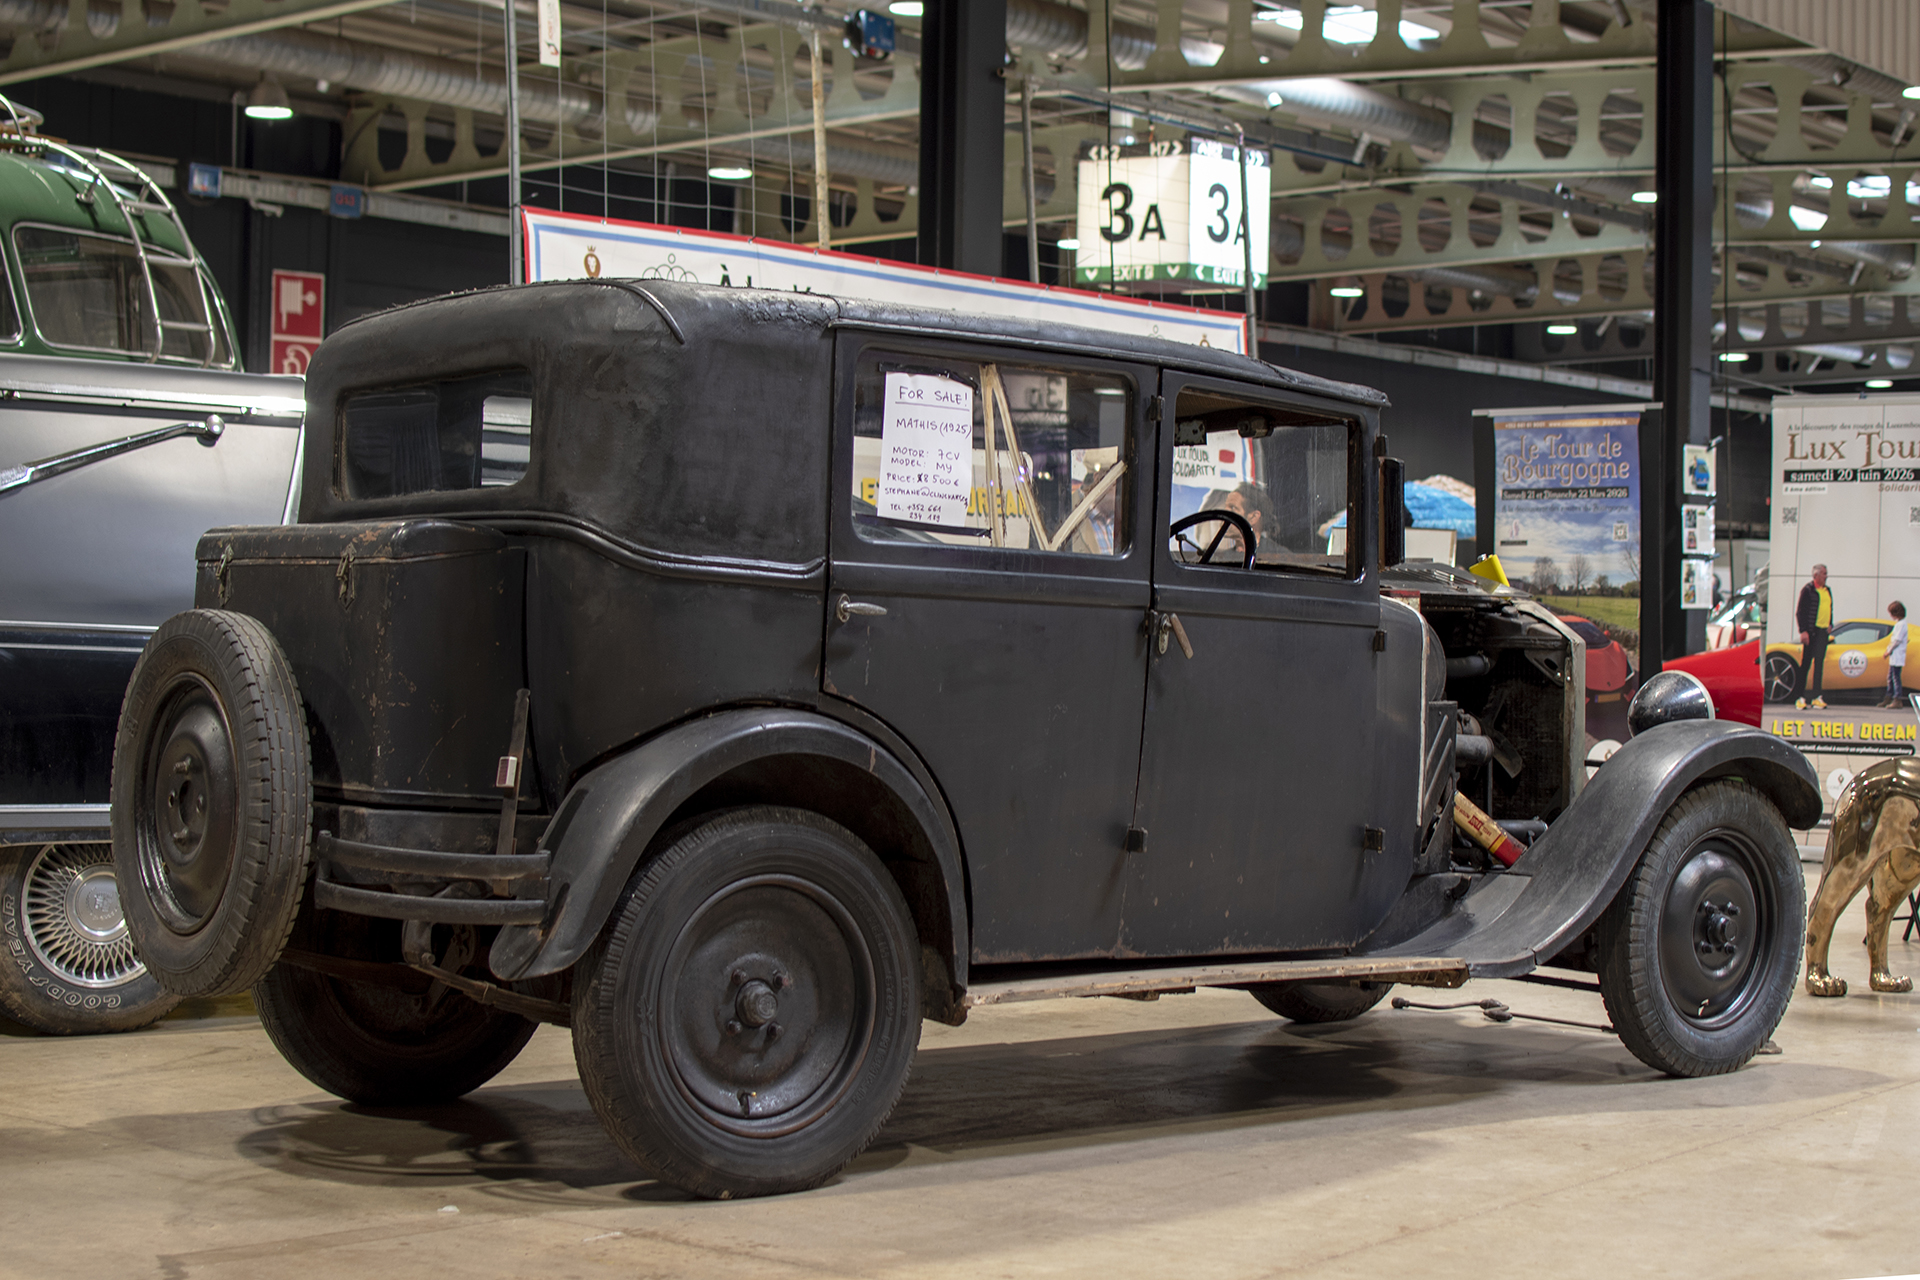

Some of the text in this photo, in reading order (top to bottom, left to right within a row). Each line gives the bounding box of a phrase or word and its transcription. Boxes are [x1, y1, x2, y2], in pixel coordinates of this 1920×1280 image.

[1100, 182, 1166, 243] 3A
[899, 385, 968, 407] FOR SALE!
[896, 418, 972, 440] MATHIS (1925)
[892, 446, 929, 458] MOTOR:
[1189, 447, 1210, 463] TOUR
[1519, 432, 1623, 464] Le Tour de
[1783, 430, 1920, 468] Lux Tou
[890, 457, 926, 468] MODEL:
[1172, 460, 1216, 478] OLIDARITY
[1503, 454, 1631, 487] Bourgogne
[886, 472, 915, 484] PRICE:
[1790, 468, 1915, 484] samedi 20 juin 2026
[1503, 490, 1526, 500] Samedi
[1544, 489, 1577, 499] Dimanche
[1578, 489, 1589, 498] 22
[1606, 487, 1628, 498] 2026
[927, 504, 942, 513] 661
[1772, 719, 1917, 742] LET THEM DREAM
[3, 894, 122, 1010] GOODYEAR
